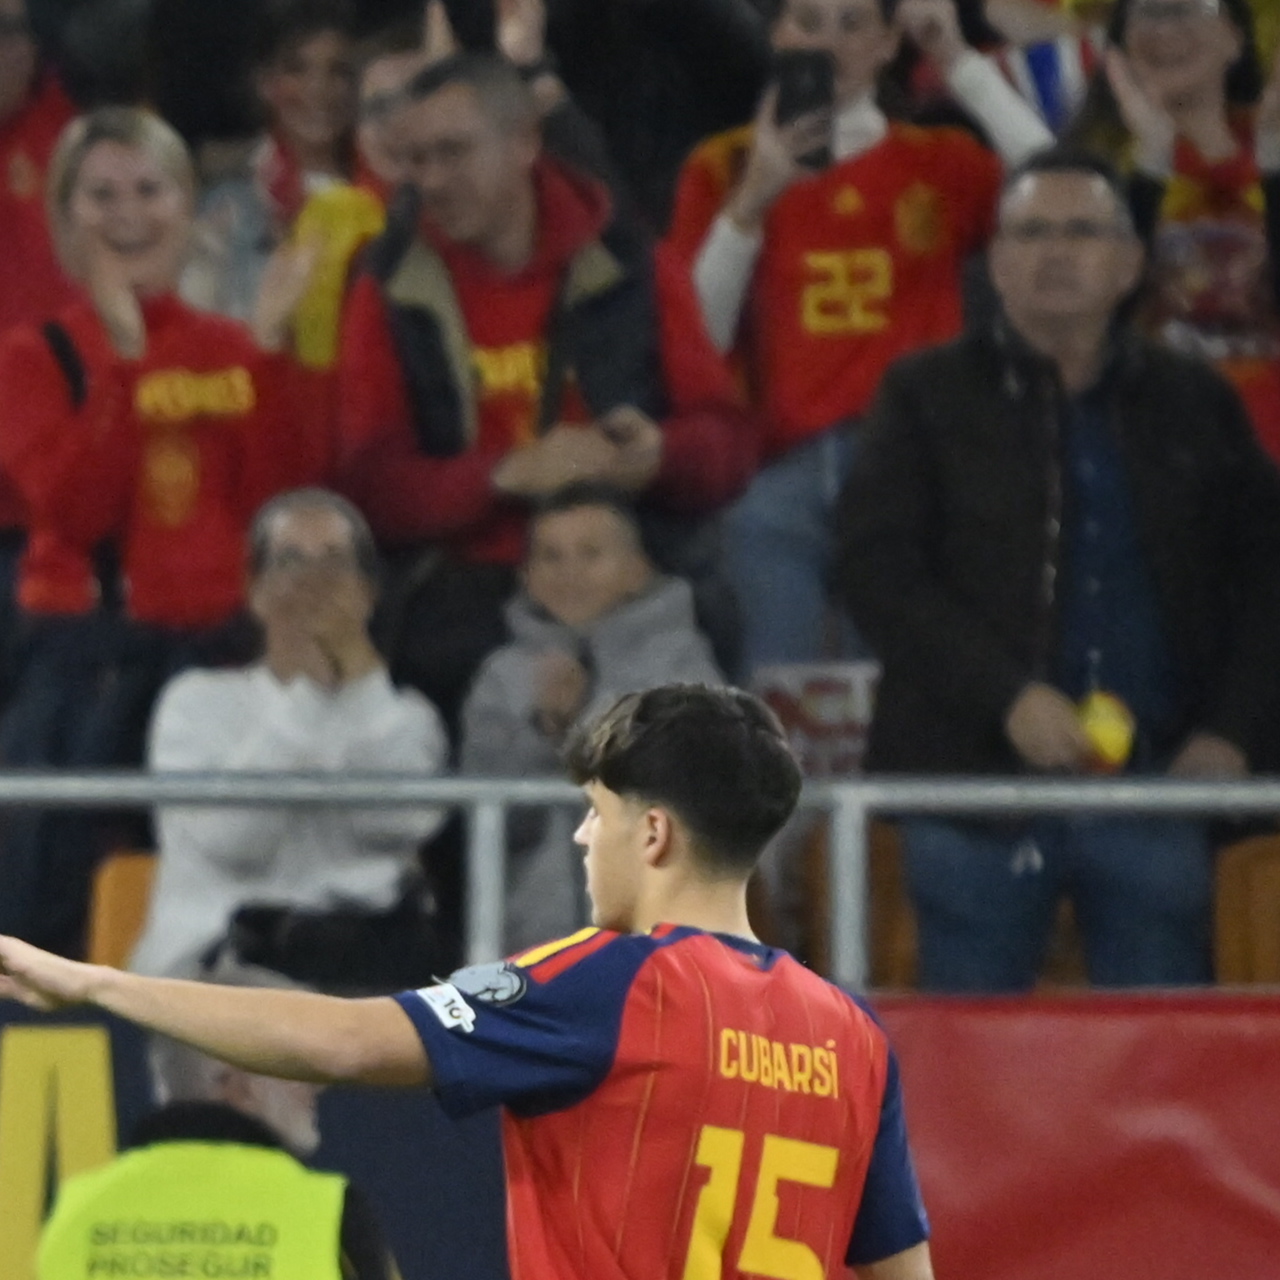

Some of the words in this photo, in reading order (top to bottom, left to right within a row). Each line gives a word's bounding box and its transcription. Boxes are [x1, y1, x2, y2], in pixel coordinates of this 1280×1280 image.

[799, 247, 895, 335] 22
[719, 1026, 840, 1101] CUBARSÍ
[88, 1221, 278, 1249] SEGURIDAD
[87, 1251, 273, 1280] PROSEGUR
